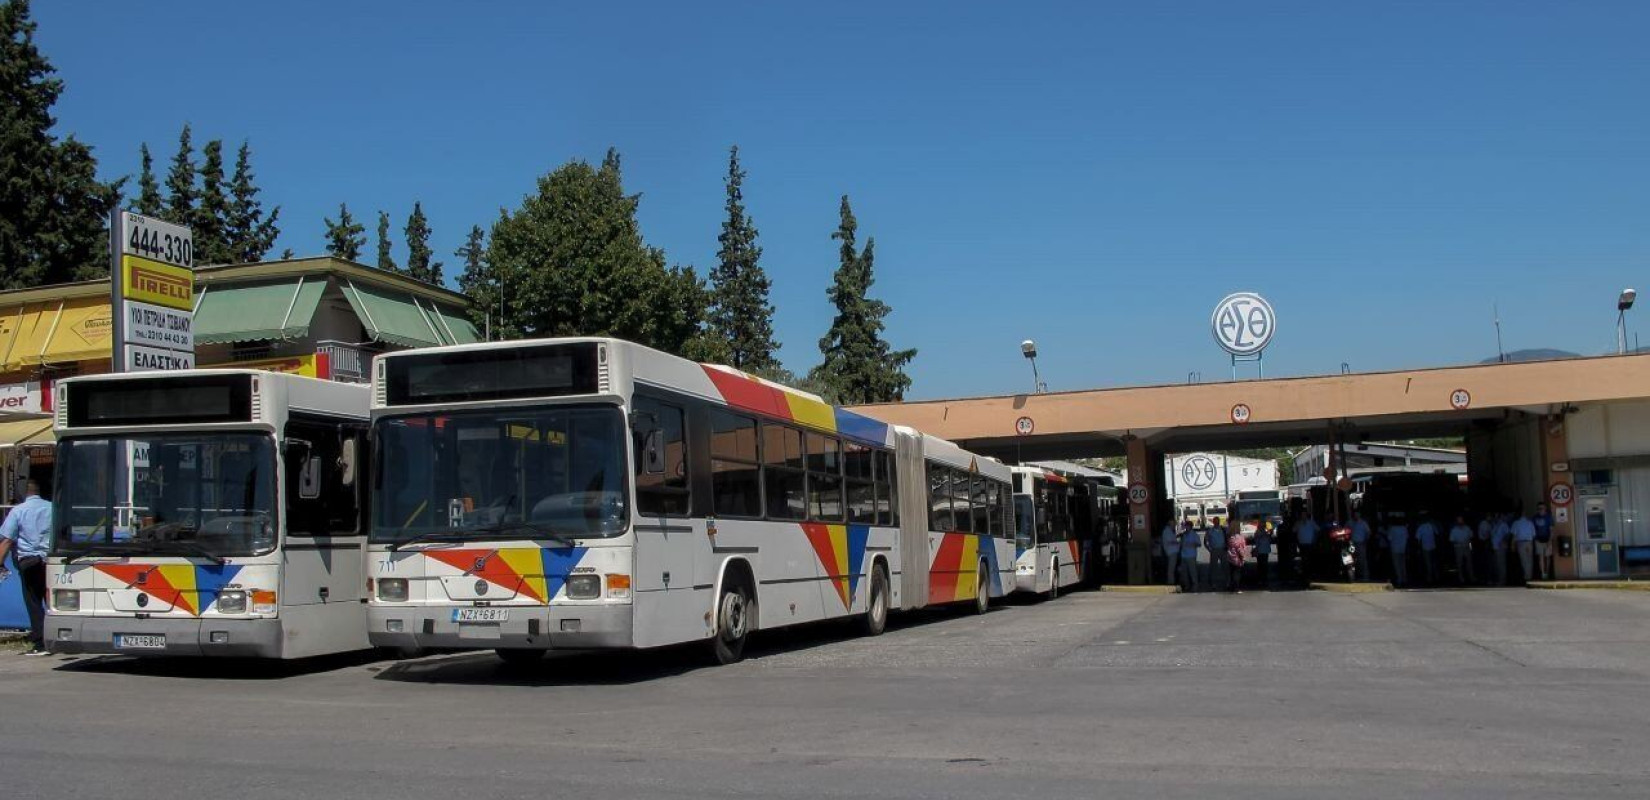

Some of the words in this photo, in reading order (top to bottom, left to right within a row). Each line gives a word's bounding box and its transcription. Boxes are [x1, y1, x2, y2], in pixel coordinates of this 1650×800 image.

[130, 225, 192, 266] 444-330
[131, 266, 192, 300] PIRELLI
[134, 352, 190, 370] ΕΛΑΣΤΙΚΑ
[1132, 489, 1147, 499] 20
[1553, 488, 1570, 499] 20
[379, 560, 395, 572] 711
[55, 573, 73, 584] 704
